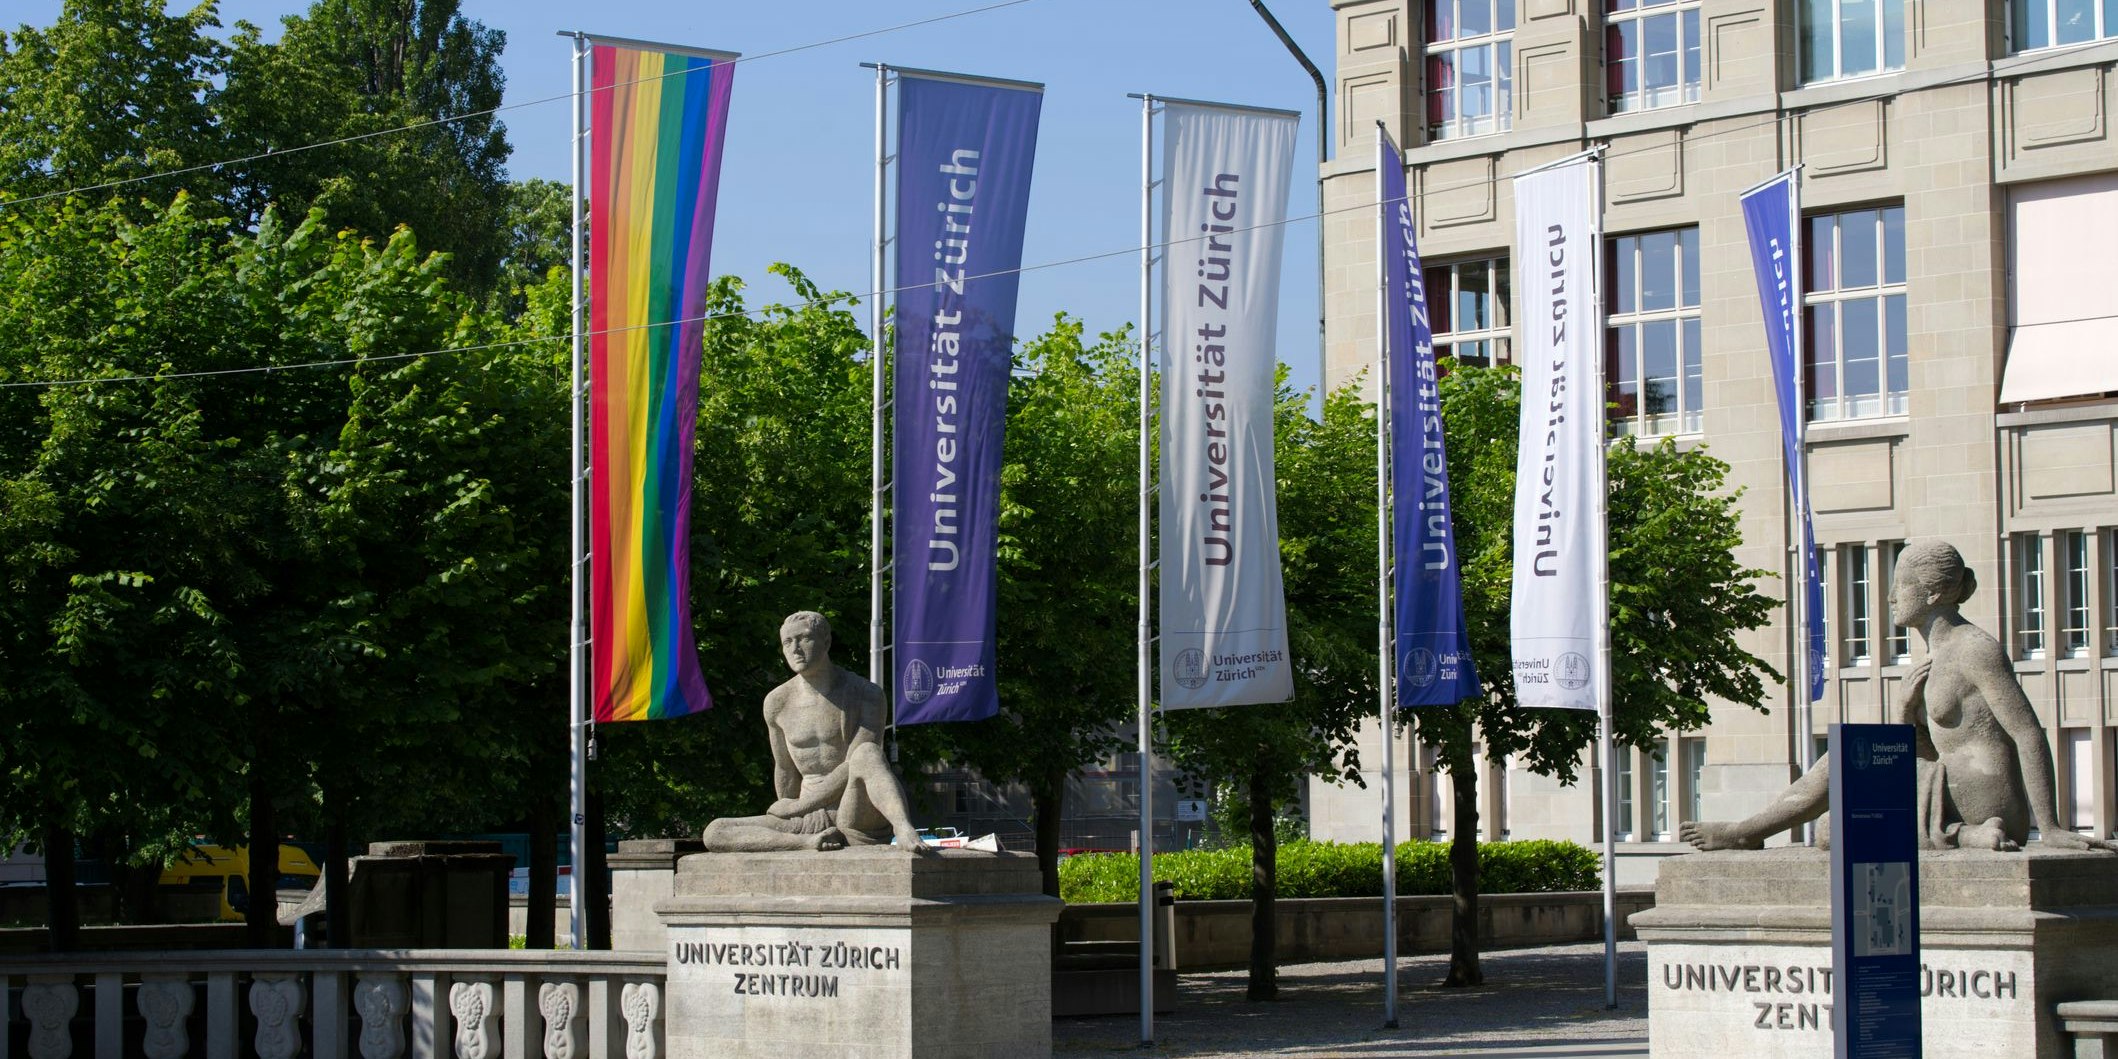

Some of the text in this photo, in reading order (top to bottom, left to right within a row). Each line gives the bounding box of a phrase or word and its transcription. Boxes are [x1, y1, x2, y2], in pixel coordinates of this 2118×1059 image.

[928, 148, 980, 572] Universität Zürich
[1198, 172, 1240, 568] Universität Zürich
[1399, 202, 1449, 570] Universität Zürich
[936, 664, 985, 679] Universität
[1213, 650, 1283, 666] Universität
[1215, 667, 1256, 682] Zürich
[1440, 668, 1457, 680] Züri
[936, 682, 960, 696] Zürich
[675, 941, 900, 970] UNIVERSITÄT ZÜRICH
[734, 973, 839, 998] ZENTRUM
[1663, 963, 2017, 1000] UNIVERSIT ÜRICH
[1753, 1002, 1835, 1032] ZENT
